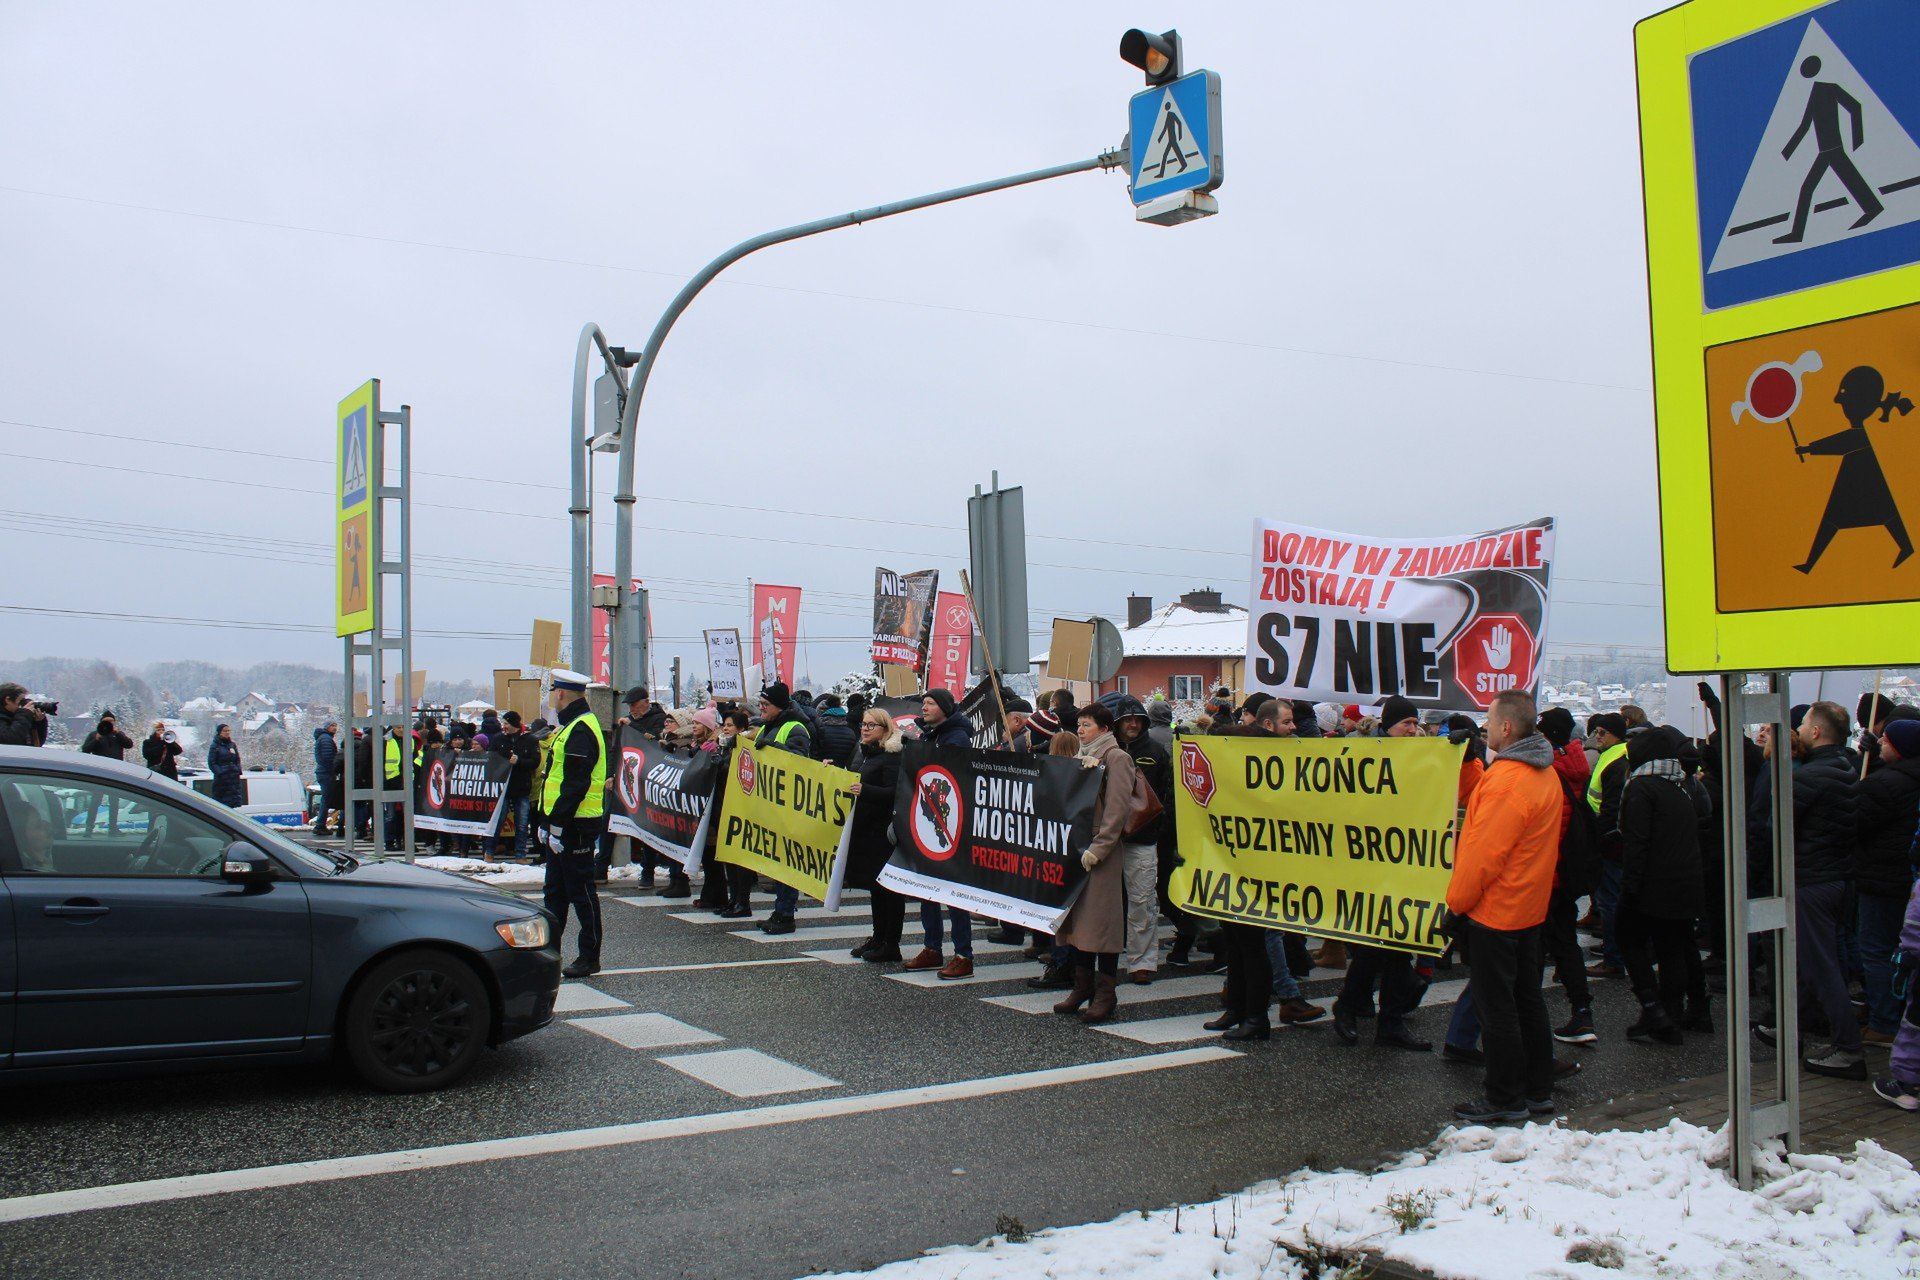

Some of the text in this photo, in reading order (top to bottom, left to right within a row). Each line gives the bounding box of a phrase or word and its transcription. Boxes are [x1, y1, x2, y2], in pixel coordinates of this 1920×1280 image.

[1263, 528, 1543, 578] DOMY W ZAWADZIE
[1260, 567, 1395, 614] ZOSTAJĄ !
[1256, 612, 1440, 698] S7 NIE
[1476, 672, 1518, 692] STOP
[450, 780, 505, 798] MOGILANY
[452, 764, 485, 780] GMINA
[756, 761, 856, 827] NIE DLA S7
[975, 775, 1034, 814] GMINA
[1245, 747, 1398, 795] DO KOŃCA
[645, 780, 710, 817] MOGILANY
[725, 815, 839, 884] PRZEZ KRAKÓ
[972, 807, 1073, 856] MOGILANY
[1208, 813, 1453, 870] BĘDZIEMY BRONIĆ
[971, 845, 1065, 886] PRZECIW S7 i S52
[1187, 868, 1451, 945] NASZEGO MIASTA
